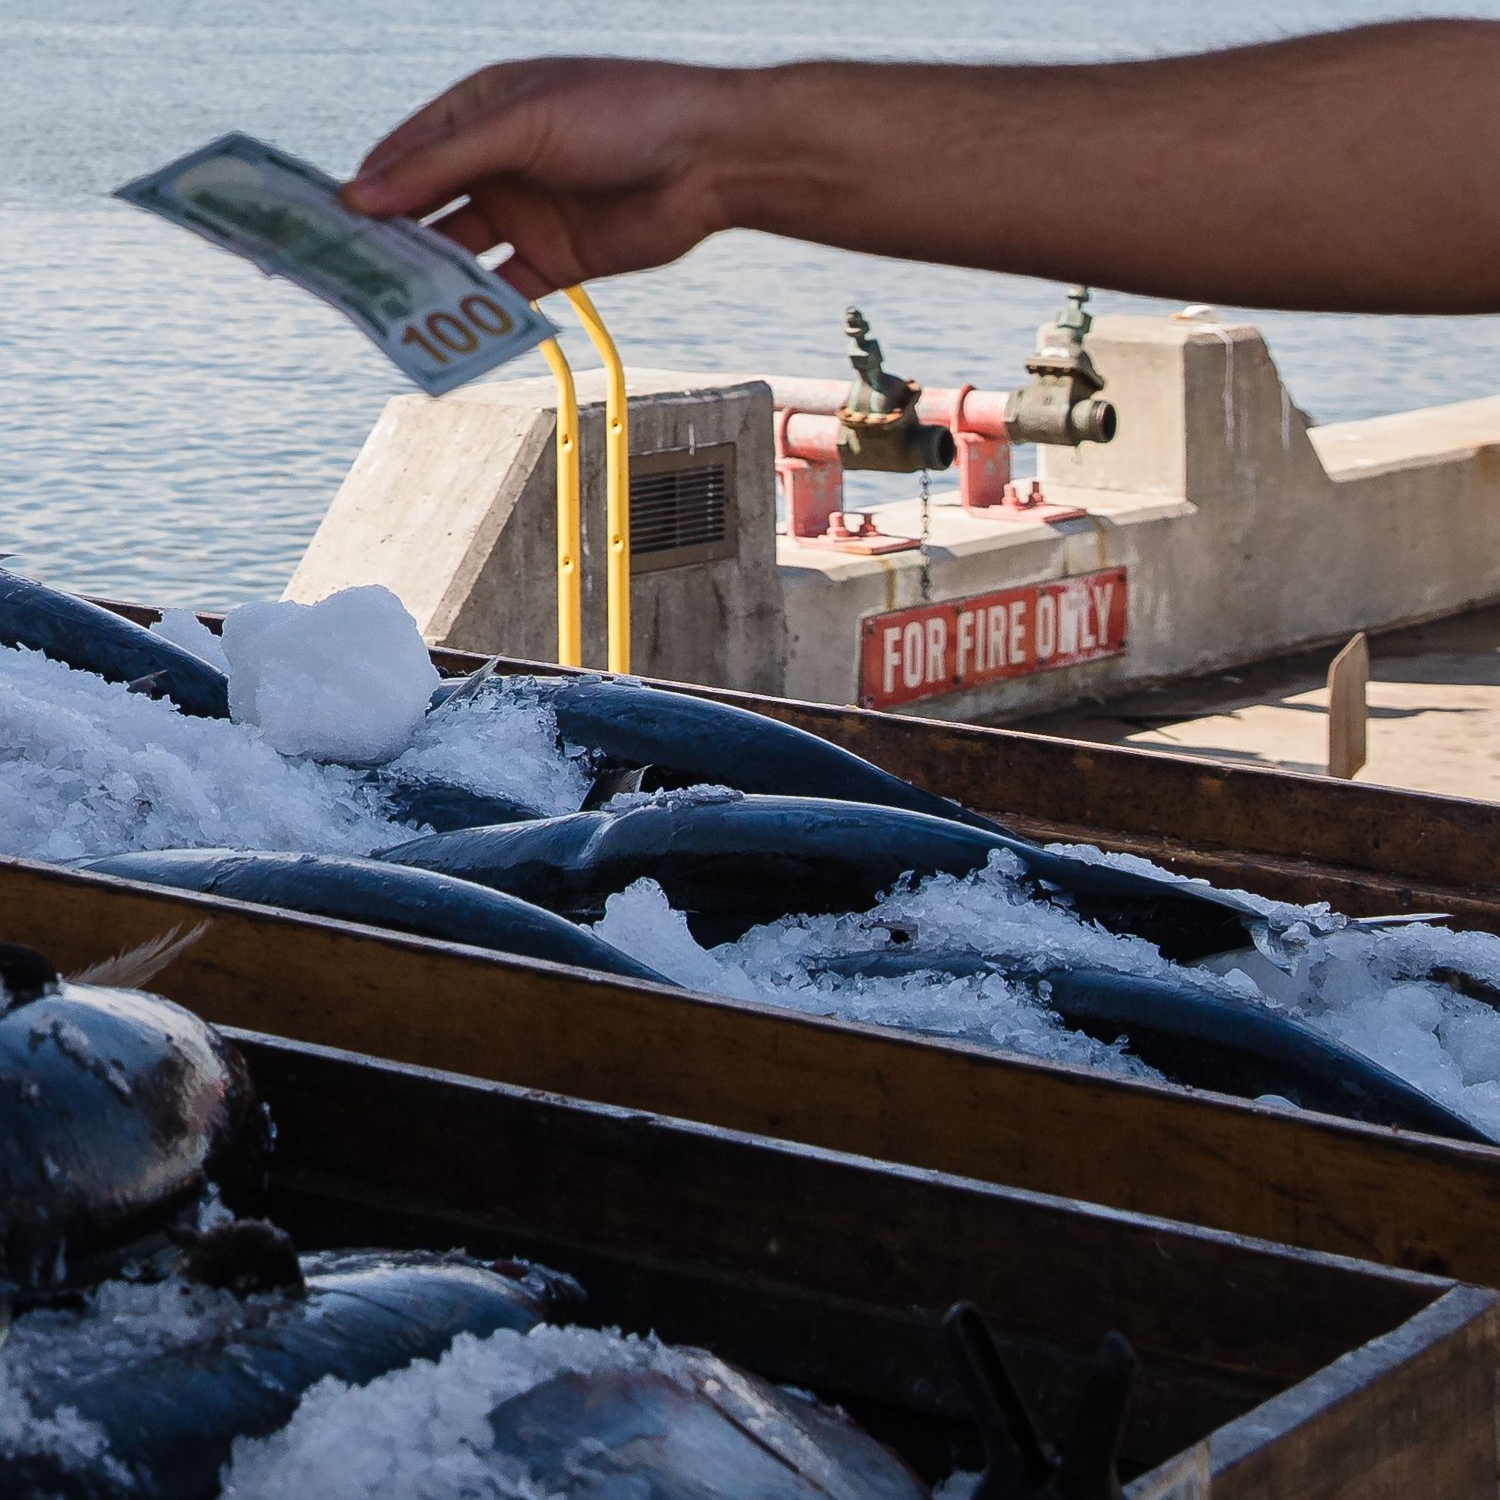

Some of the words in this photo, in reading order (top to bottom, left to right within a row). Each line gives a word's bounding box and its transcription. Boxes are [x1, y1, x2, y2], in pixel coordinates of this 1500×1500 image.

[401, 294, 515, 366] 100
[883, 617, 947, 694] FOR
[956, 600, 1027, 676] FIRE
